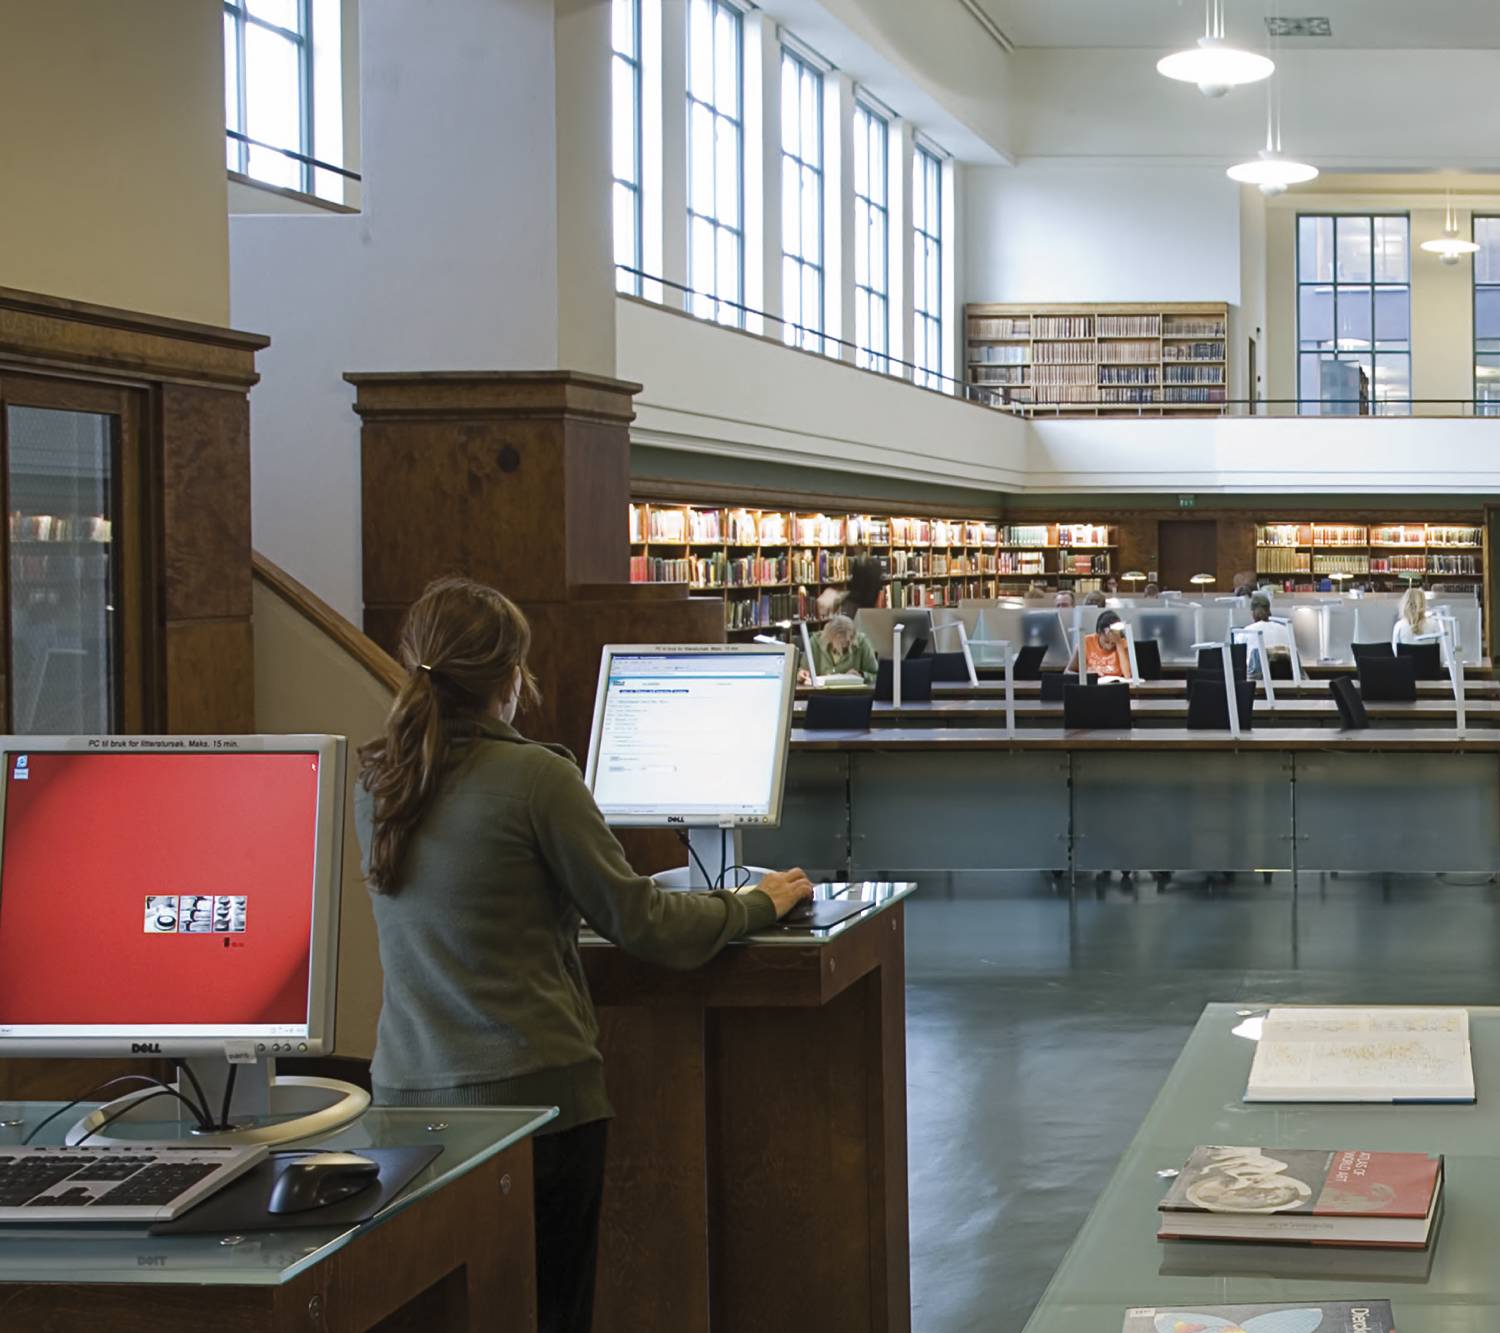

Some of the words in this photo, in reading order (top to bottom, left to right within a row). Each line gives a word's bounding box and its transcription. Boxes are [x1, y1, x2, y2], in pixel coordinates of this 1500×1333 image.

[110, 740, 126, 748] bruk
[128, 740, 139, 748] for
[188, 740, 210, 748] Maks.
[212, 740, 222, 748] 15
[132, 1043, 162, 1054] DELL
